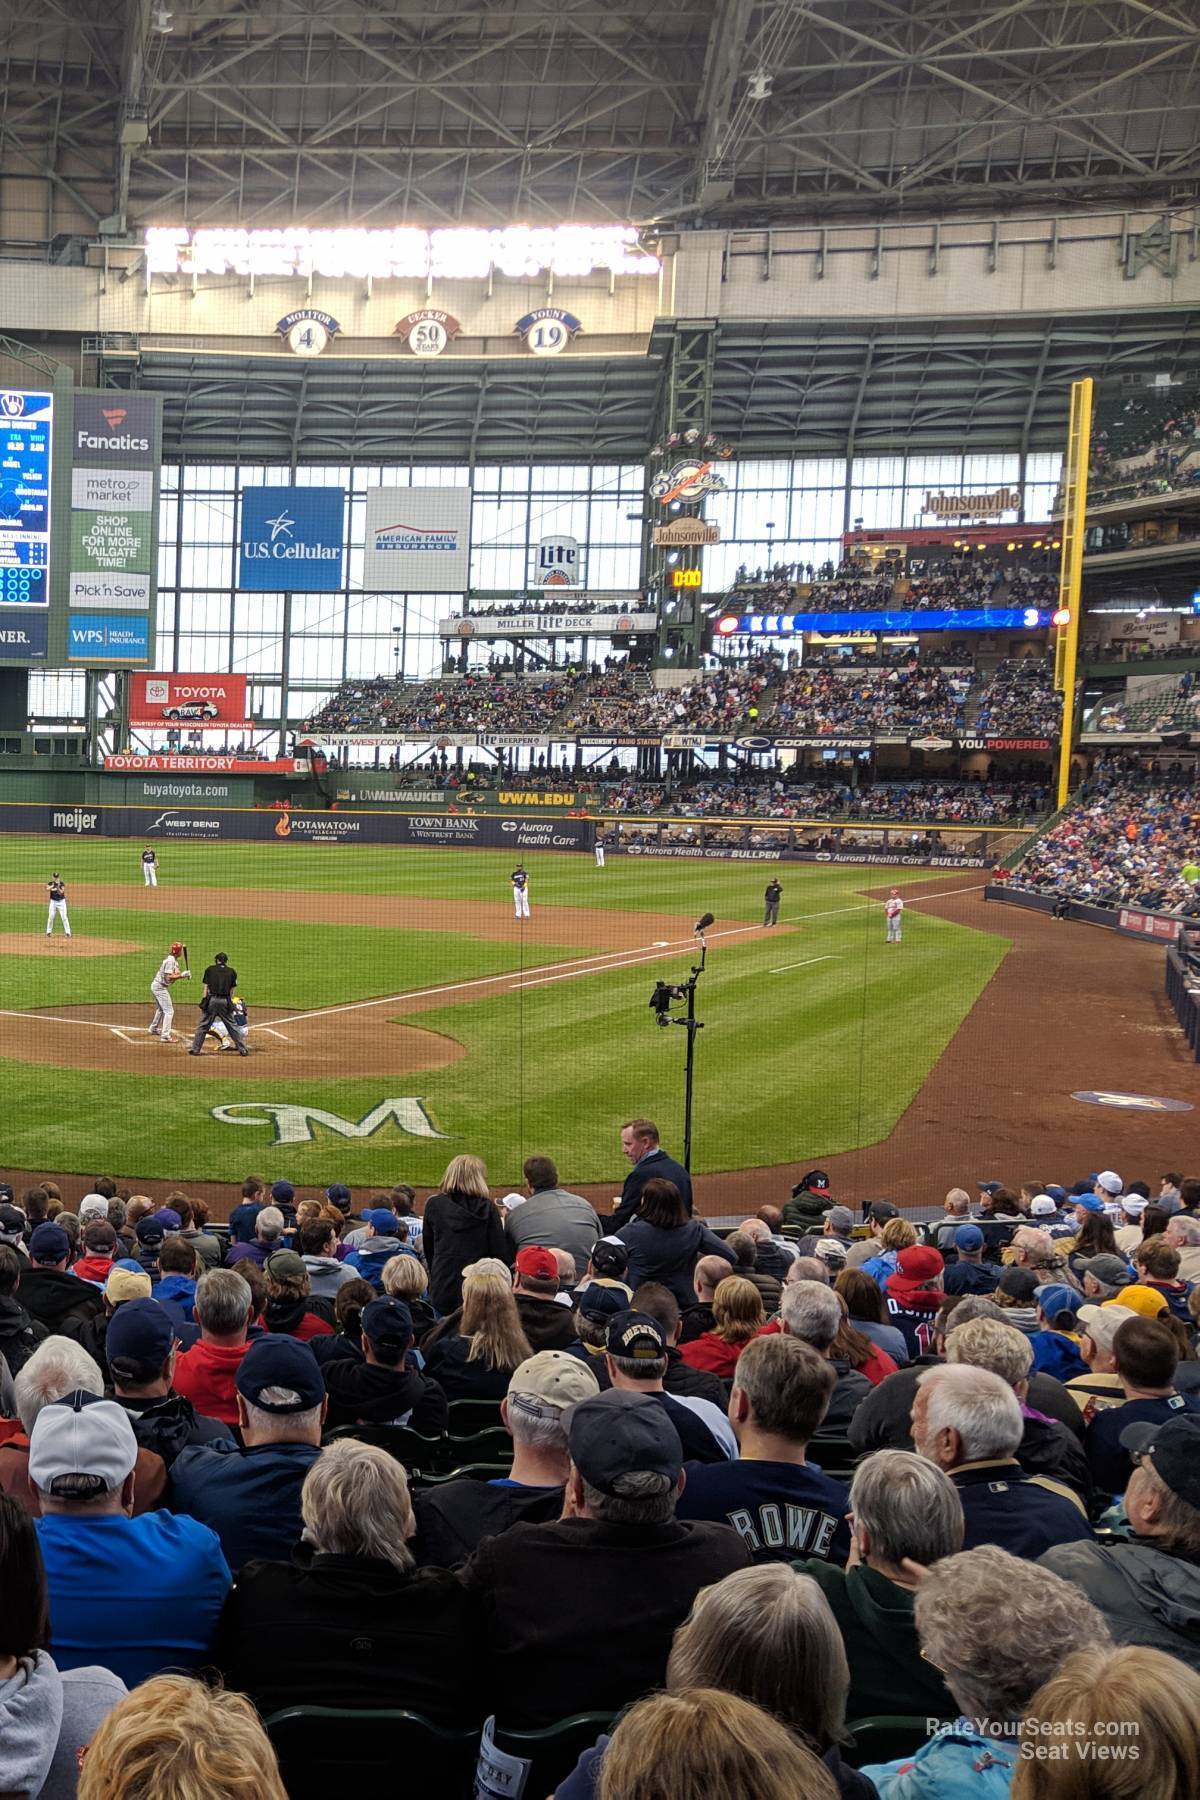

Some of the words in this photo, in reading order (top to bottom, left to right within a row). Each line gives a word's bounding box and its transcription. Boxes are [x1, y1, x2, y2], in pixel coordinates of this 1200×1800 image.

[287, 311, 332, 326] MOLITOR
[407, 311, 448, 323] UECKER
[530, 310, 566, 321] YOUNT
[299, 327, 313, 349] 4
[415, 326, 439, 344] 50
[534, 326, 564, 348] 19
[77, 430, 149, 451] Fanatics
[87, 477, 126, 490] metro
[86, 490, 131, 502] market
[920, 487, 1022, 513] Johnsonville
[96, 515, 128, 526] SHOP
[90, 526, 133, 537] ONLINE
[655, 528, 718, 544] Johnsonville
[81, 535, 106, 547] FOR
[107, 536, 141, 547] MORE
[86, 546, 137, 558] TAILGATE
[243, 543, 270, 559] U.S.
[273, 542, 340, 560] Cellular
[539, 545, 576, 569] Lite
[95, 556, 127, 568] TIME!
[74, 584, 101, 596] Pick
[114, 585, 146, 598] Save
[497, 619, 534, 629] MILLER
[564, 618, 592, 627] DECK
[1023, 608, 1039, 626] 3
[72, 630, 104, 643] WPS
[109, 637, 146, 645] INSURANCE
[173, 687, 226, 699] TOYOTA
[107, 756, 159, 769] TOYOTA
[161, 757, 235, 770] TERRITORY
[143, 782, 229, 797] buyatoyota.com
[498, 792, 575, 806] UWM.EDU
[53, 808, 97, 833] meijer
[165, 820, 191, 828] WEST
[193, 820, 220, 829] BEND
[291, 820, 360, 831] POTAWATOMI
[407, 817, 443, 828] TOWN
[445, 818, 479, 830] BANK
[519, 822, 553, 833] Aurora
[417, 831, 453, 839] WINTRUST
[517, 834, 550, 845] Health
[552, 835, 576, 846] Care
[643, 846, 673, 856] Aurora
[675, 847, 703, 857] Health
[704, 848, 726, 858] Care
[730, 850, 781, 860] BULLPEN
[833, 853, 865, 863] Aurora
[866, 854, 898, 864] Health
[900, 856, 924, 865] Care
[930, 857, 984, 867] BULLPEN
[725, 1502, 839, 1559] ROWE
